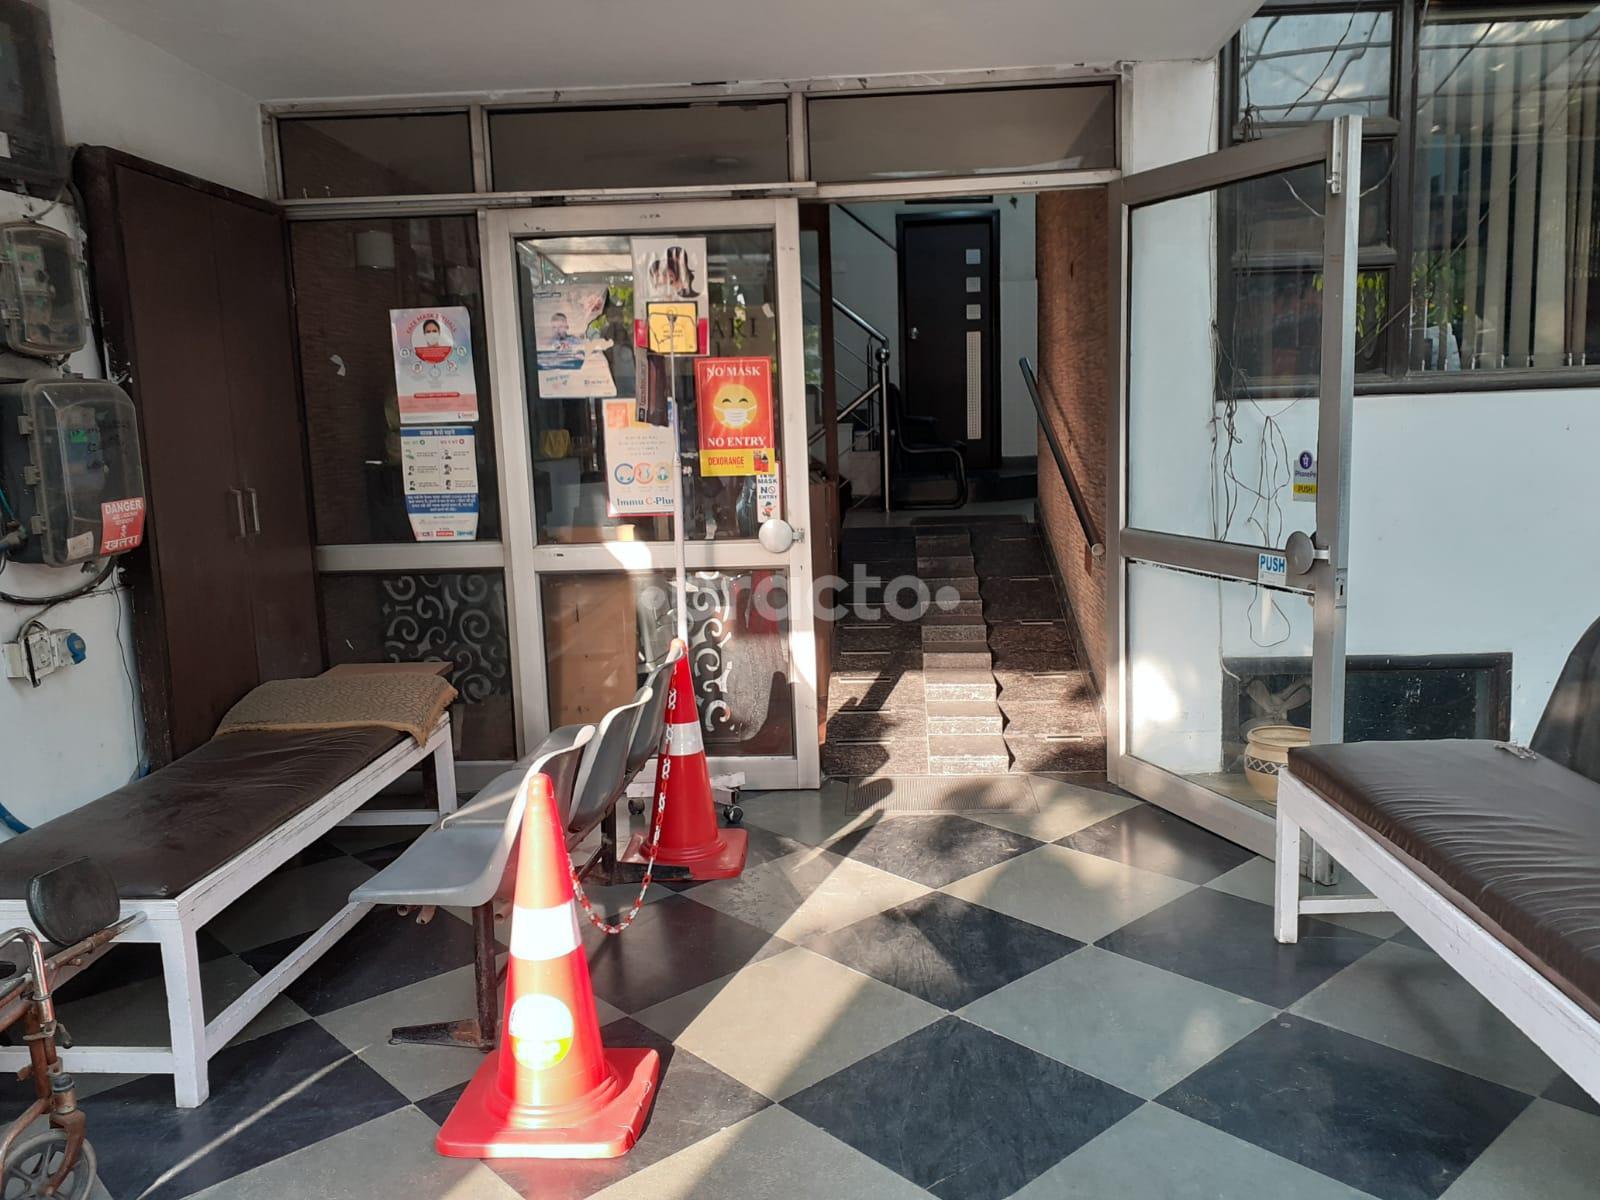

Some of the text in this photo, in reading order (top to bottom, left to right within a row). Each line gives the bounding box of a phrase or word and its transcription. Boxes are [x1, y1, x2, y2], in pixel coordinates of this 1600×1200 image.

[706, 366, 761, 377] NO MASK
[707, 436, 766, 447] NO ENTRY
[707, 456, 745, 466] DEXORANGE
[1297, 484, 1313, 494] PUSH
[105, 499, 143, 514] DANGER
[616, 498, 644, 507] Immu
[103, 535, 138, 550] खतरा
[1260, 555, 1286, 573] PUSH
